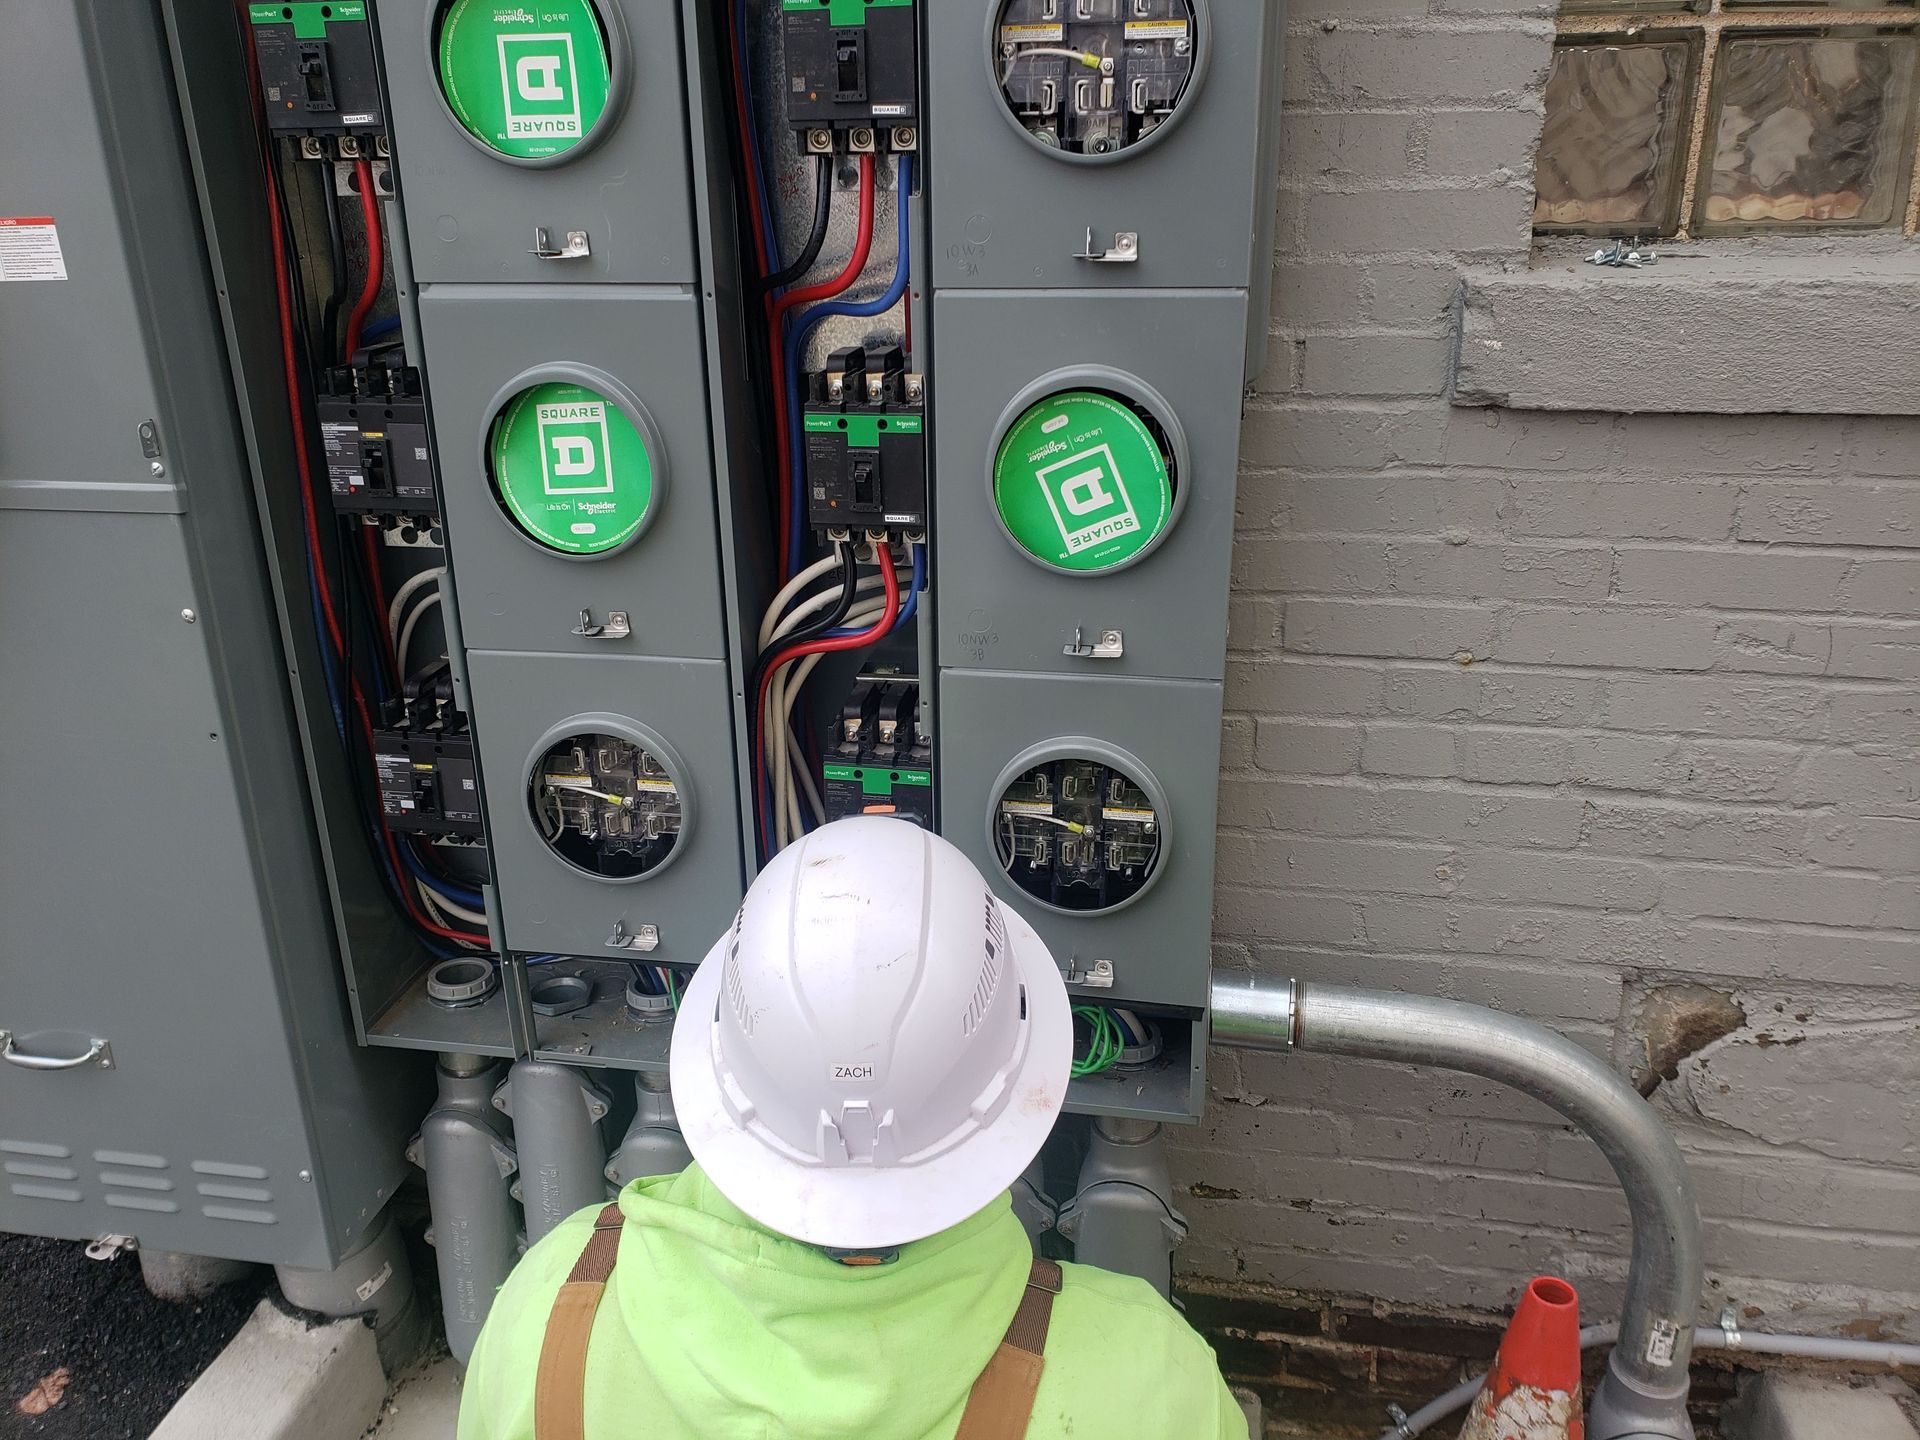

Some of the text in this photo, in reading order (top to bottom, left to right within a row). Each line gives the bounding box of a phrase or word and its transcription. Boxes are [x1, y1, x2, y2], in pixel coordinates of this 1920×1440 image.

[493, 8, 534, 24] Schneider
[542, 14, 552, 22] On
[516, 56, 564, 100] D
[512, 120, 577, 133] SQUARE
[541, 407, 600, 419] SQUARE
[552, 436, 595, 475] D
[1028, 440, 1068, 463] Schneider
[1060, 466, 1115, 516] D
[578, 502, 616, 515] Schneider
[1071, 517, 1134, 548] SQUARE
[835, 1066, 872, 1078] ZACH
